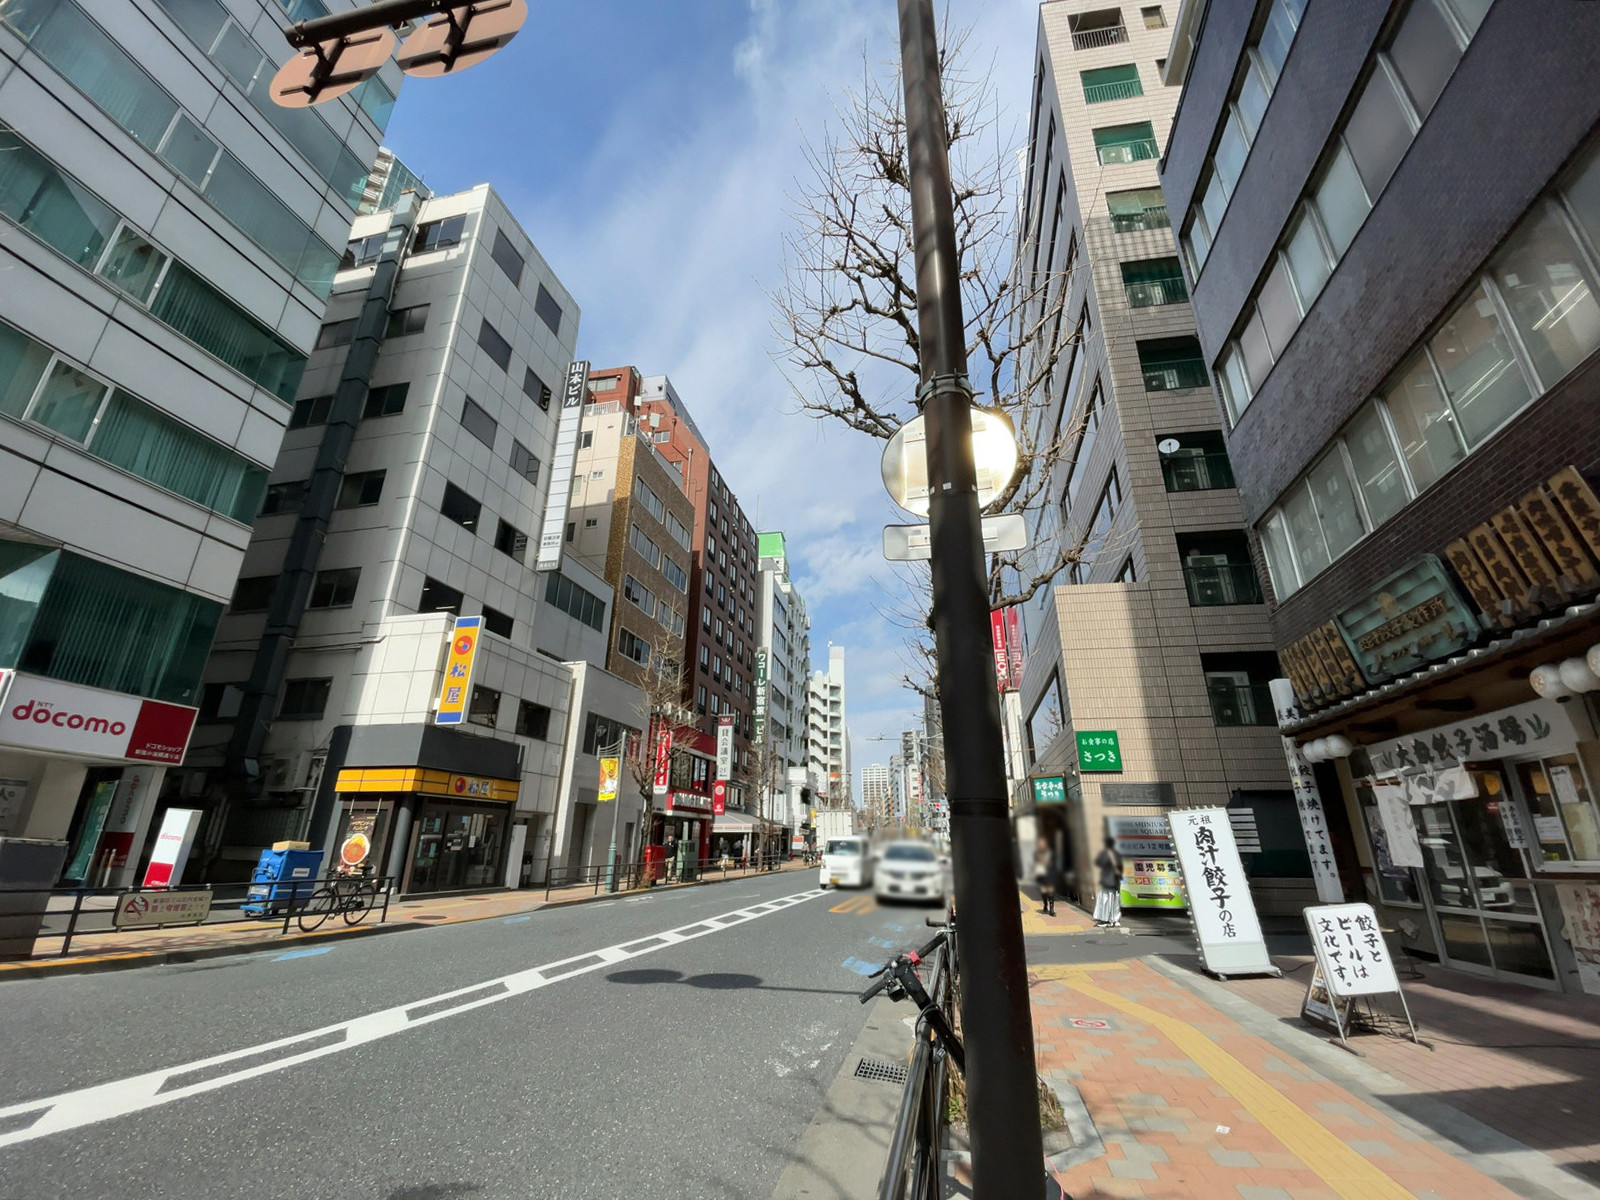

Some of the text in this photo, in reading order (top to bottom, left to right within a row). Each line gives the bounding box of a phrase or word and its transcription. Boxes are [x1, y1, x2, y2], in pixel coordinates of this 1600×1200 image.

[566, 362, 585, 407] 山本ビル
[445, 662, 467, 704] 松屋
[755, 653, 766, 744] ワコーレ新宿第一ビル
[12, 700, 126, 735] docomo
[1082, 738, 1114, 746] お食事の店
[1083, 750, 1116, 763] さつき
[468, 781, 490, 795] 松屋
[161, 833, 182, 841] docomo
[1188, 815, 1212, 826] 元祖
[1134, 862, 1177, 872] 園児募集
[1194, 826, 1236, 938] 肉汁餃子の店
[1318, 918, 1352, 987] 文化です。
[1336, 916, 1369, 978] ビールは
[1355, 915, 1382, 963] 餃子と
